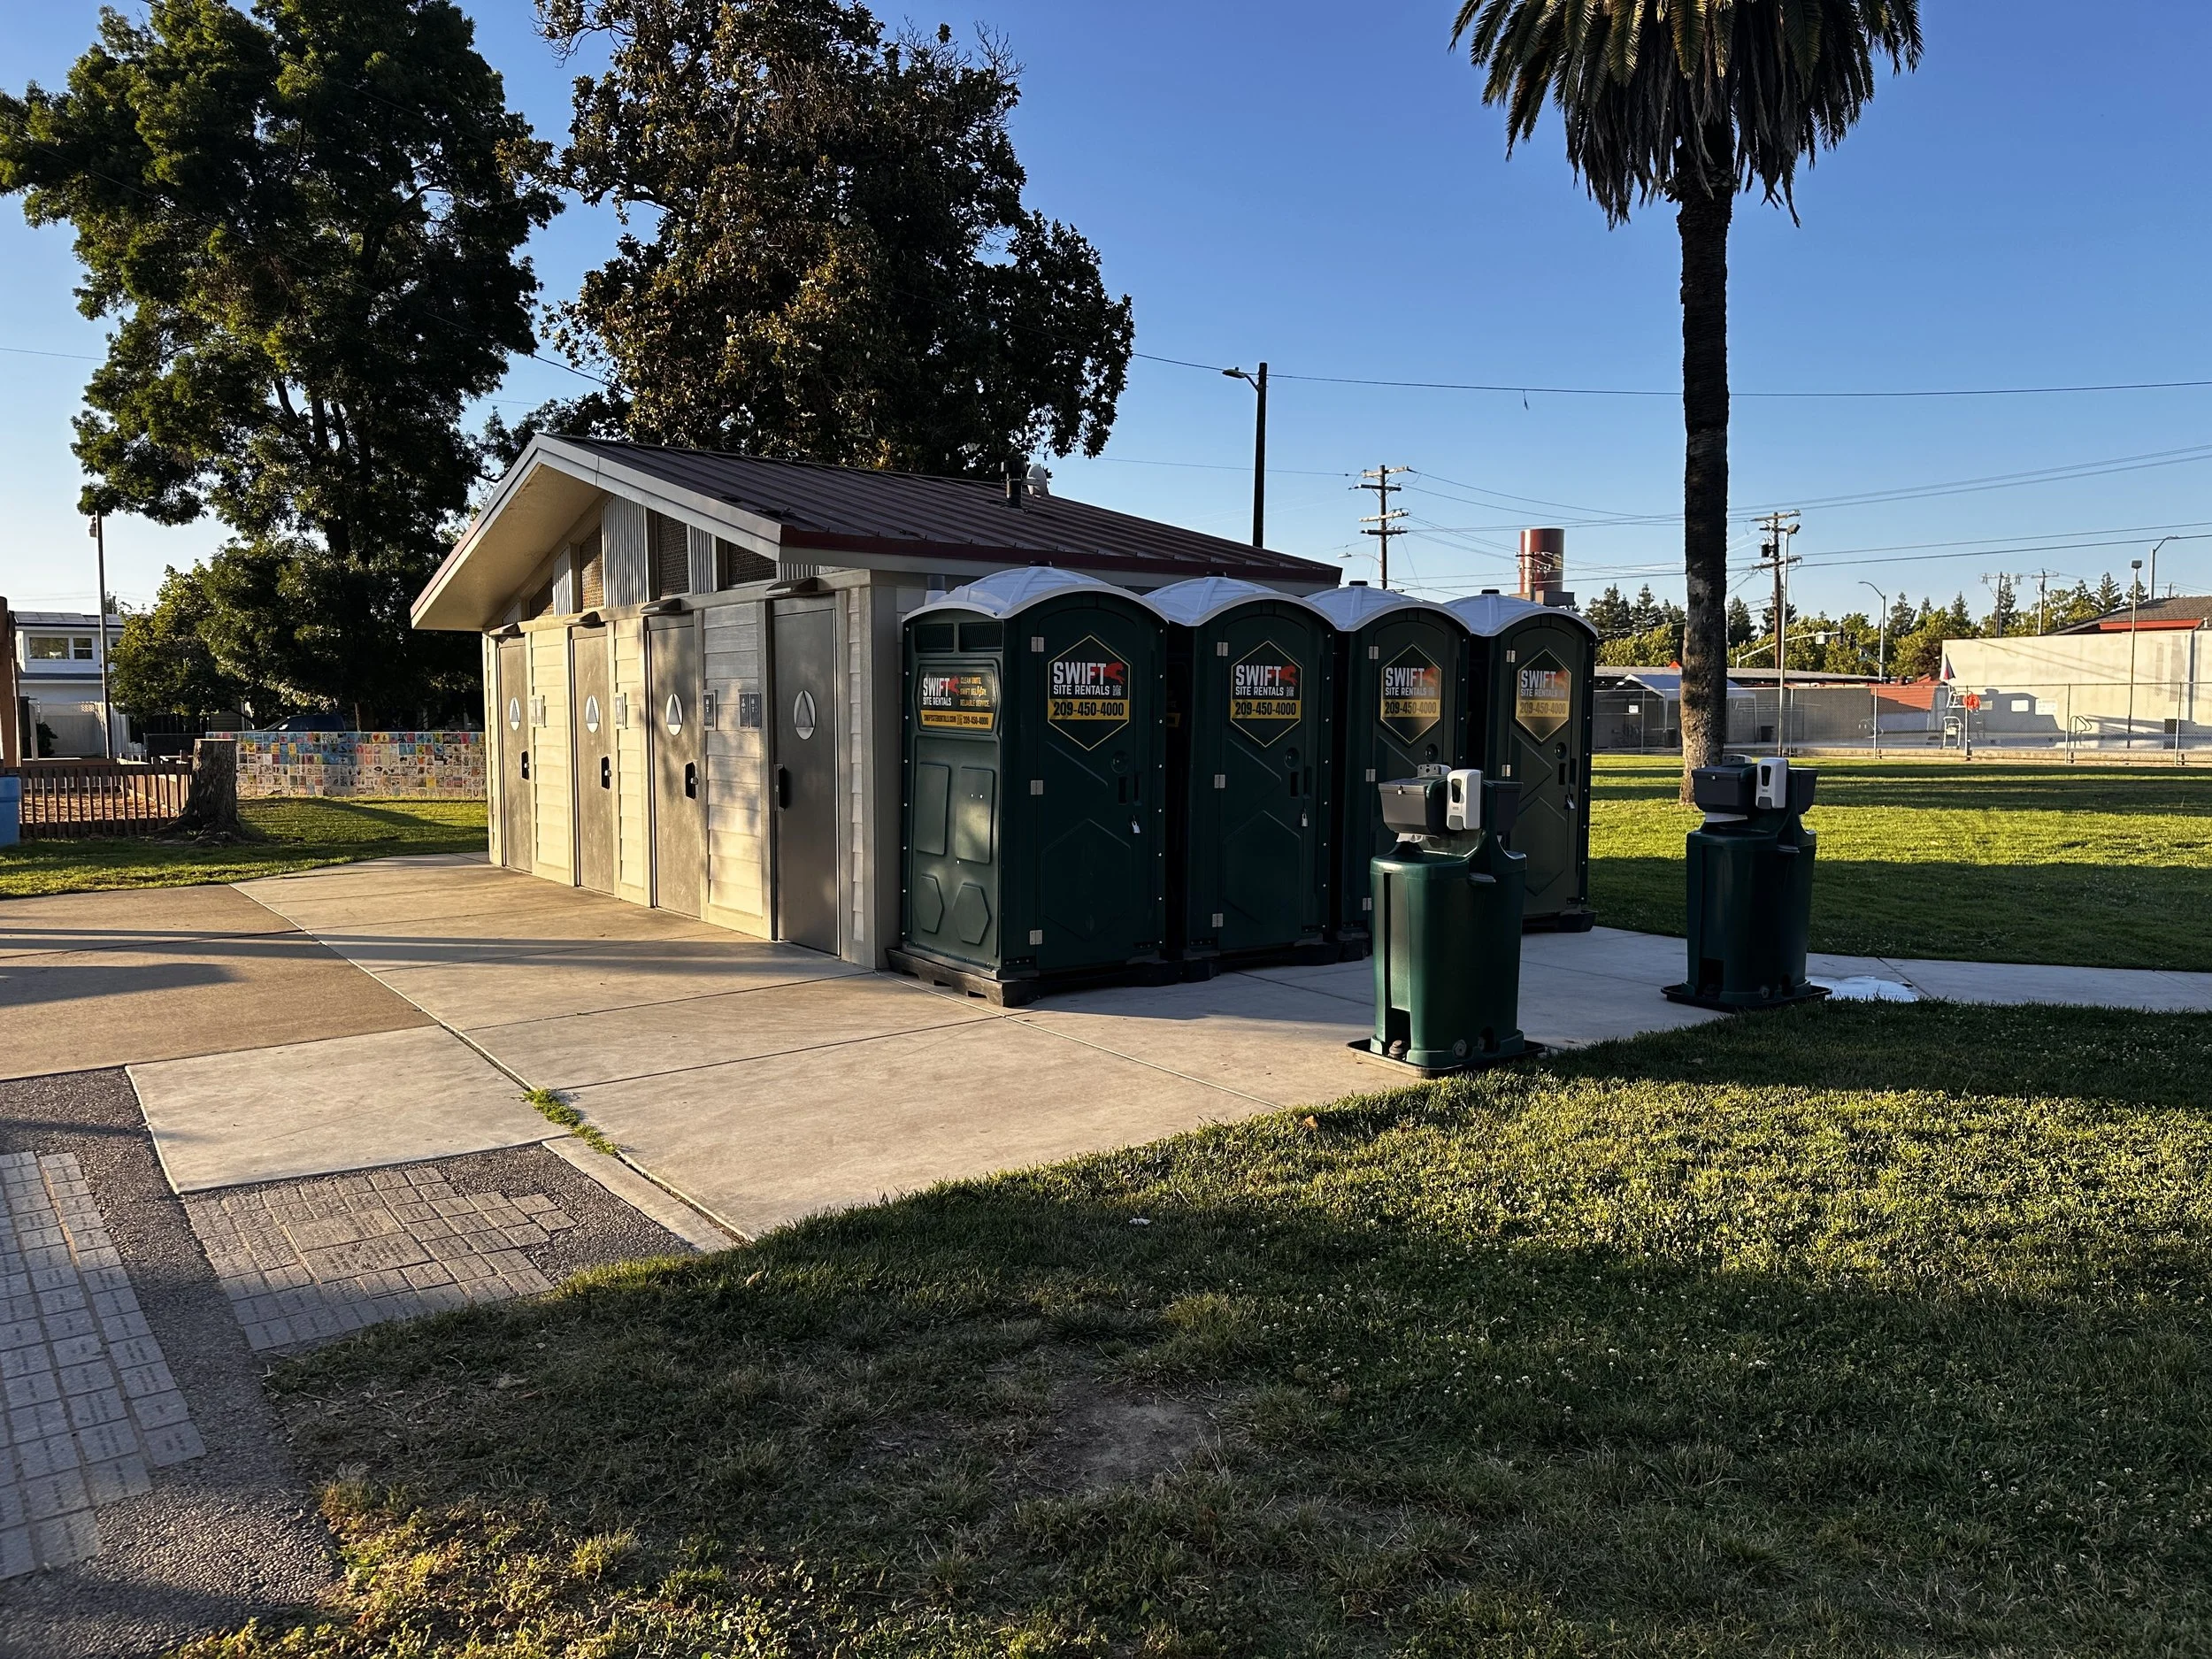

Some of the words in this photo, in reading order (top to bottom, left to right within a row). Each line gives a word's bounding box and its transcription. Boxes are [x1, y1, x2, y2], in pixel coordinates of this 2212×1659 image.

[1053, 661, 1107, 685] SWIFT
[1235, 664, 1282, 687] SWIFT
[1385, 667, 1425, 687] SWIFT
[1521, 670, 1556, 688] SWIFT
[923, 677, 949, 697] SWIFT
[1053, 684, 1072, 695] SITE
[1074, 684, 1110, 695] RENTALS
[1235, 686, 1252, 696] SITE
[1253, 686, 1285, 696] RENTALS
[1385, 687, 1400, 696] SITE
[1401, 687, 1427, 696] RENTALS
[1520, 688, 1534, 697] SITE
[923, 696, 932, 706] SITE
[933, 696, 952, 706] RENTALS
[1053, 701, 1125, 717] 209-450-4000
[1234, 702, 1296, 716] 209-450-4000
[1385, 702, 1437, 714] 209-450-4000
[1519, 702, 1566, 715] 209-450-4000
[963, 715, 989, 725] 209-450-4000
